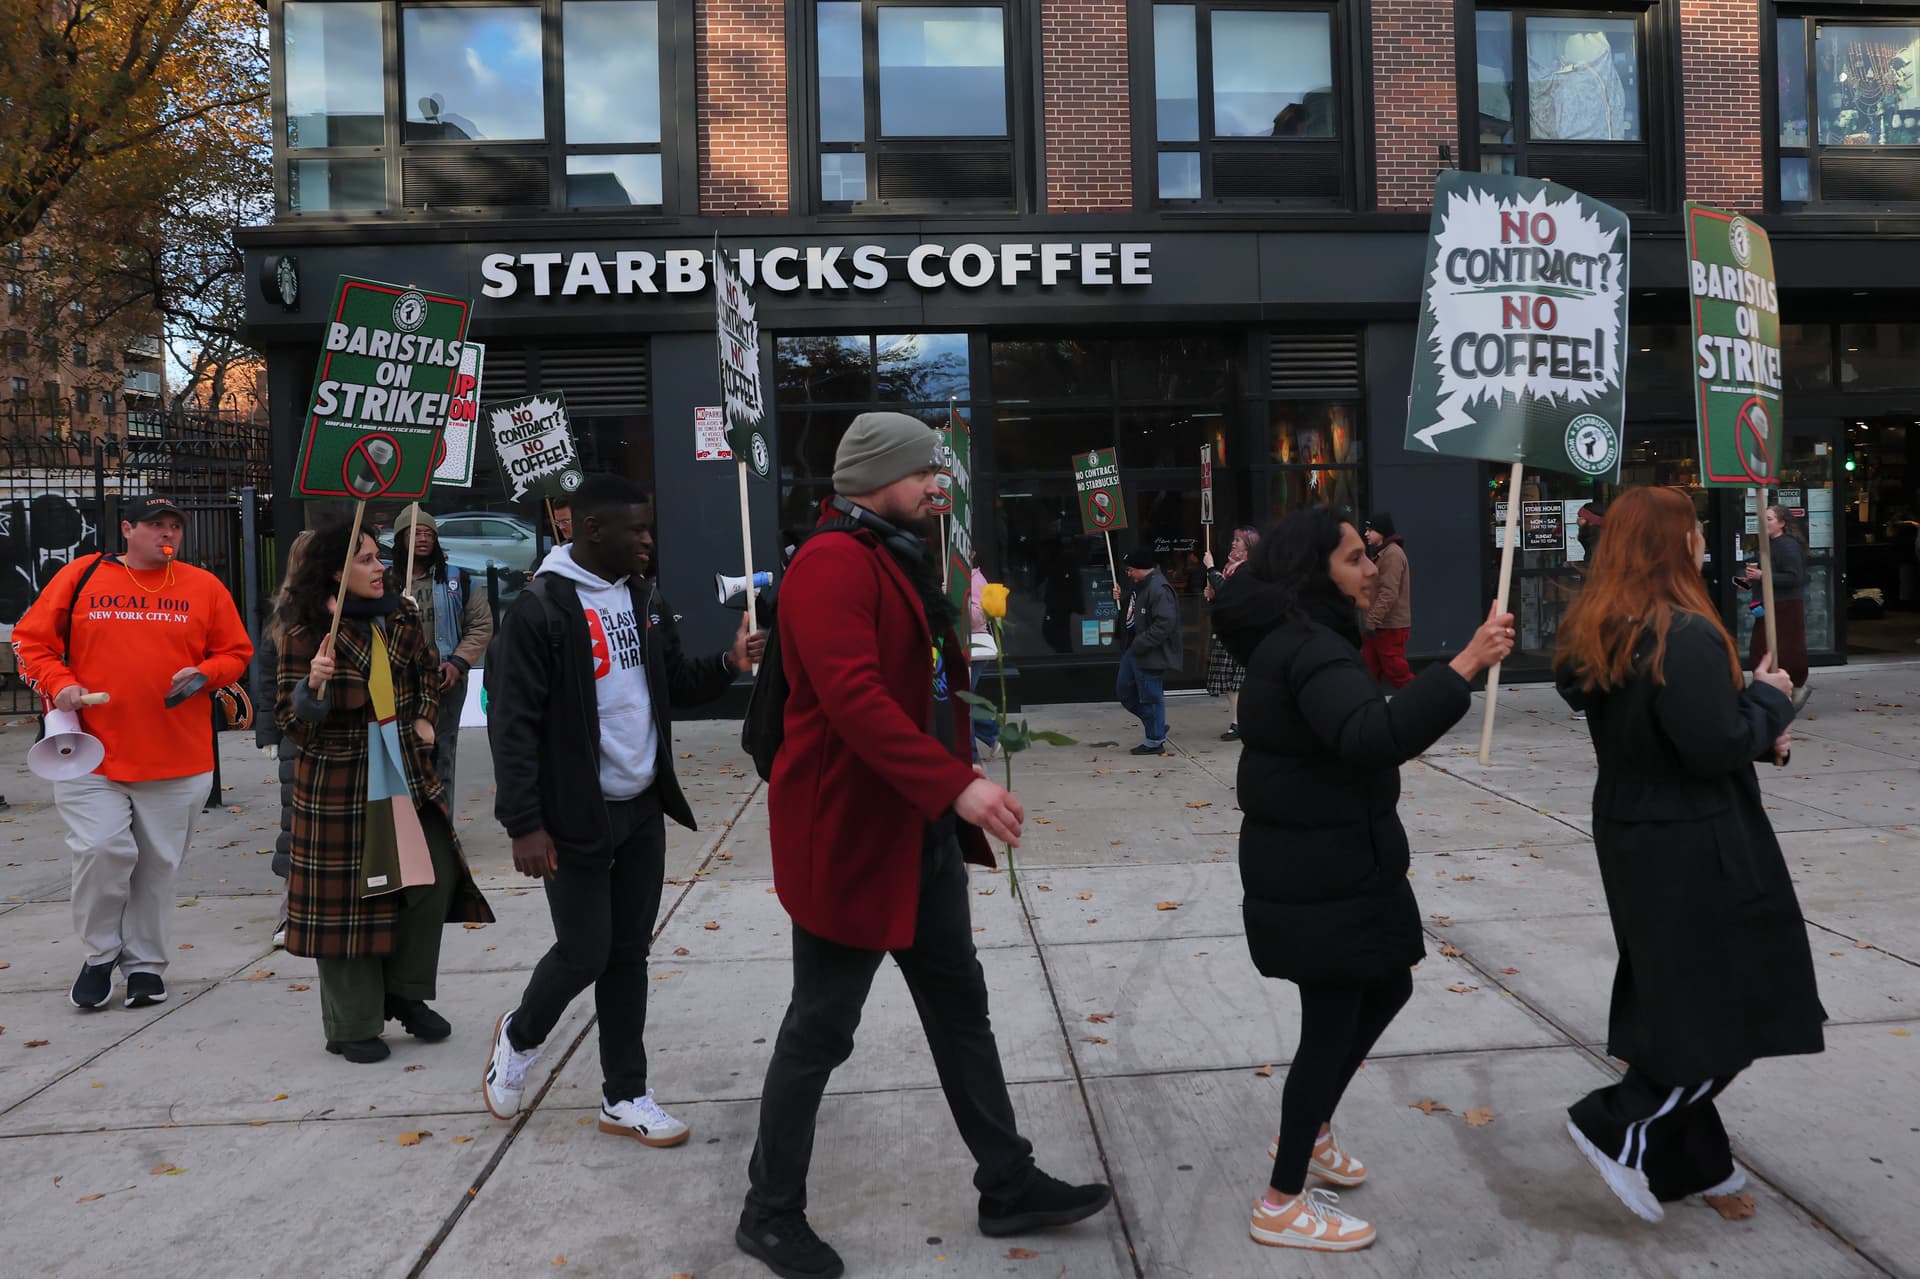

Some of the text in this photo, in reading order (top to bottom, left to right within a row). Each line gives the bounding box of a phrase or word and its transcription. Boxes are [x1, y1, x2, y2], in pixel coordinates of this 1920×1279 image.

[1499, 211, 1557, 246] NO
[907, 243, 1152, 288] COFFEE
[1445, 247, 1612, 293] CONTRACT?
[725, 278, 739, 310] NO
[1691, 259, 1778, 314] BARISTAS
[1501, 295, 1558, 330] NO
[1735, 305, 1760, 339] ON
[326, 322, 462, 368] BARISTAS
[730, 340, 744, 370] NO
[1450, 328, 1606, 382] COFFEE!
[375, 361, 413, 388] ON
[1698, 334, 1783, 390] STRIKE!
[724, 360, 759, 411] COFFEE!
[312, 380, 450, 427] STRIKE!
[511, 410, 533, 425] NO
[499, 411, 561, 445] CONTRACT?
[1573, 417, 1612, 438] STARBUCKS
[511, 439, 568, 476] COFFEE!
[521, 439, 544, 456] NO
[1568, 438, 1590, 470] WORKERS
[1596, 447, 1615, 470] UNITED
[1075, 471, 1084, 481] NO
[1077, 476, 1121, 492] NO STARBUCKS!
[89, 611, 188, 623] NEW YORK CITY, NY
[90, 595, 190, 612] LOCAL 1010
[608, 625, 640, 651] THA
